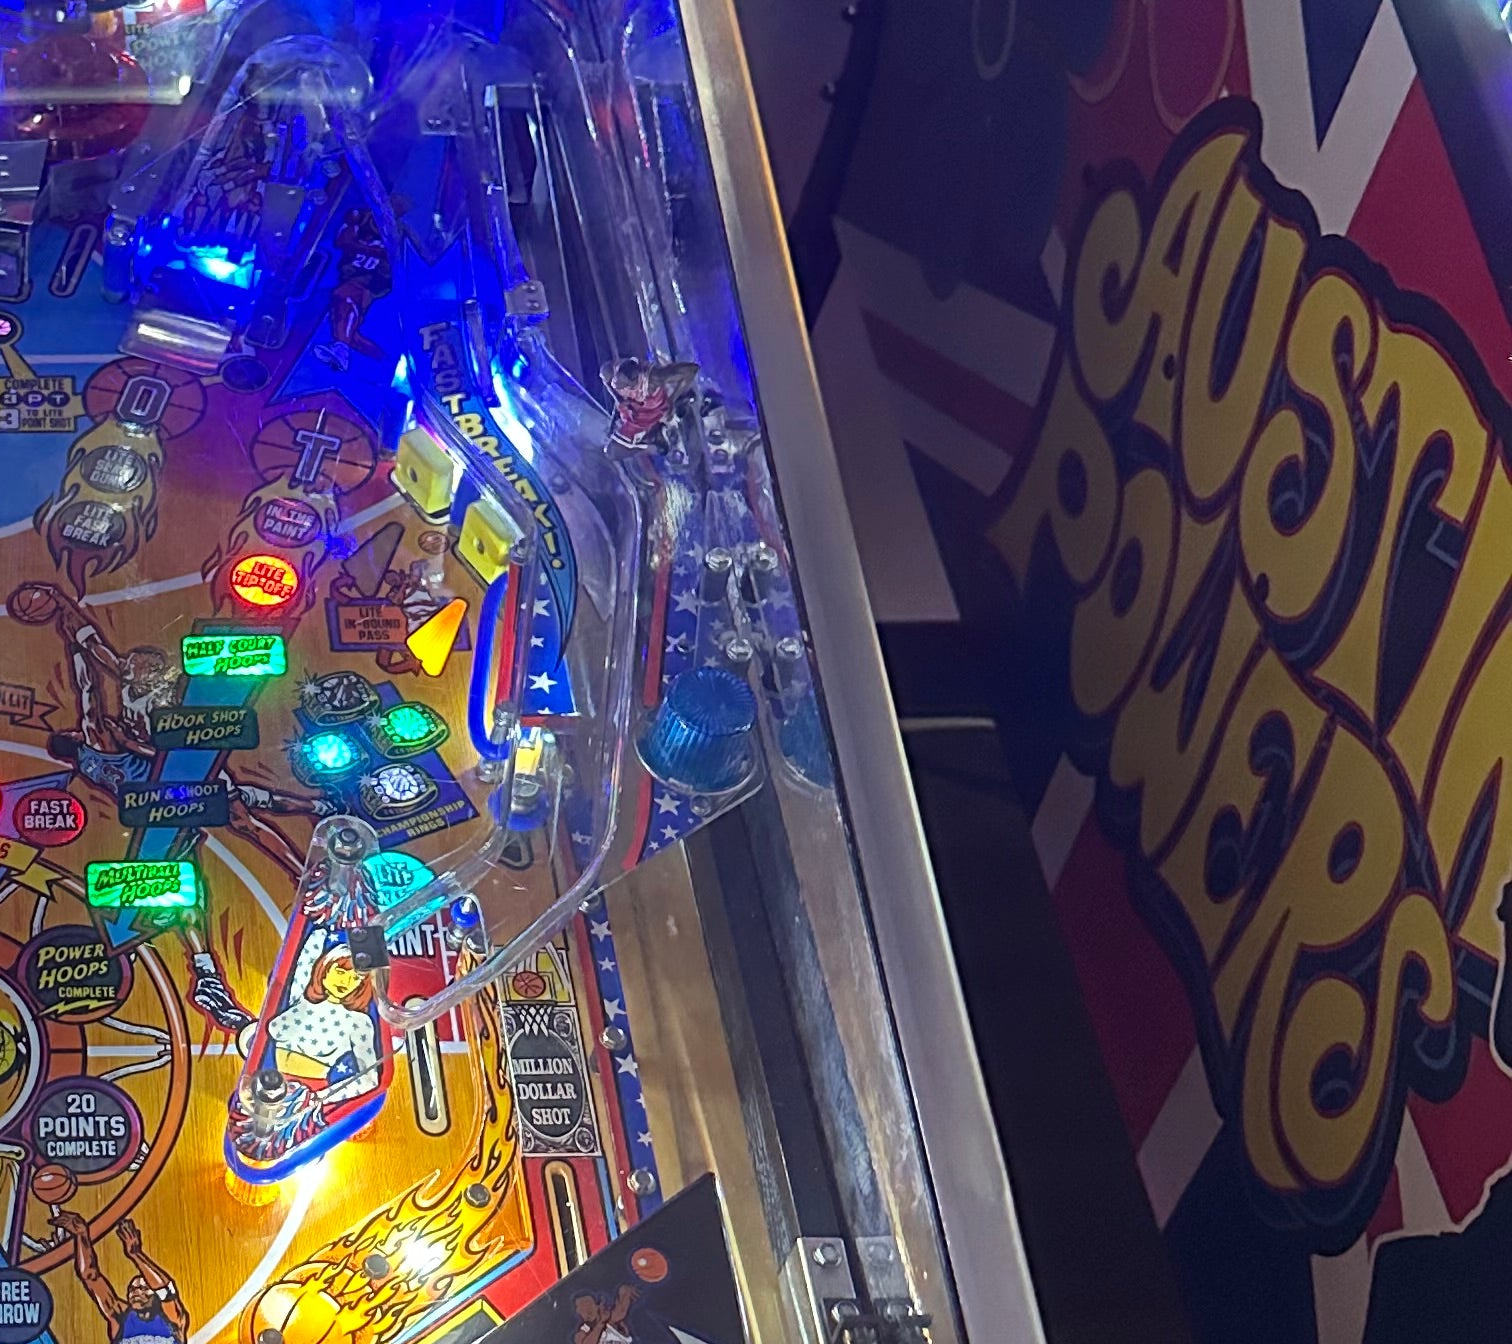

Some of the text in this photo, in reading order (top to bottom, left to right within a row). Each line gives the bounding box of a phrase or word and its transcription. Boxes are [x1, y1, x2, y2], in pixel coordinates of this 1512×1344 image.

[5, 378, 65, 390] COMPLETE
[117, 376, 172, 425] O
[296, 430, 341, 483] T
[63, 525, 111, 547] BREAK
[264, 518, 309, 540] PAINT
[254, 561, 286, 580] LITE
[358, 630, 390, 641] PASS
[188, 640, 224, 658] HALF
[9, 690, 30, 709] LIT
[157, 709, 248, 733] HOOK SHOT
[186, 724, 242, 746] HOOPS
[983, 361, 1456, 1201] POWERS
[30, 799, 70, 814] FAST
[124, 788, 161, 809] RUN
[24, 814, 77, 830] BREAK
[149, 803, 206, 823] HOOPS
[407, 818, 446, 837] RINGS
[122, 881, 182, 905] HOOPS
[38, 944, 105, 968] POWER
[39, 960, 109, 990] HOOPS
[58, 987, 116, 999] COMPLETE
[512, 1057, 574, 1076] MILLION
[518, 1082, 578, 1101] DOLLAR
[66, 1093, 95, 1114] 20
[532, 1106, 572, 1126] SHOT
[38, 1116, 126, 1139] POINTS
[46, 1139, 117, 1158] COMPLETE
